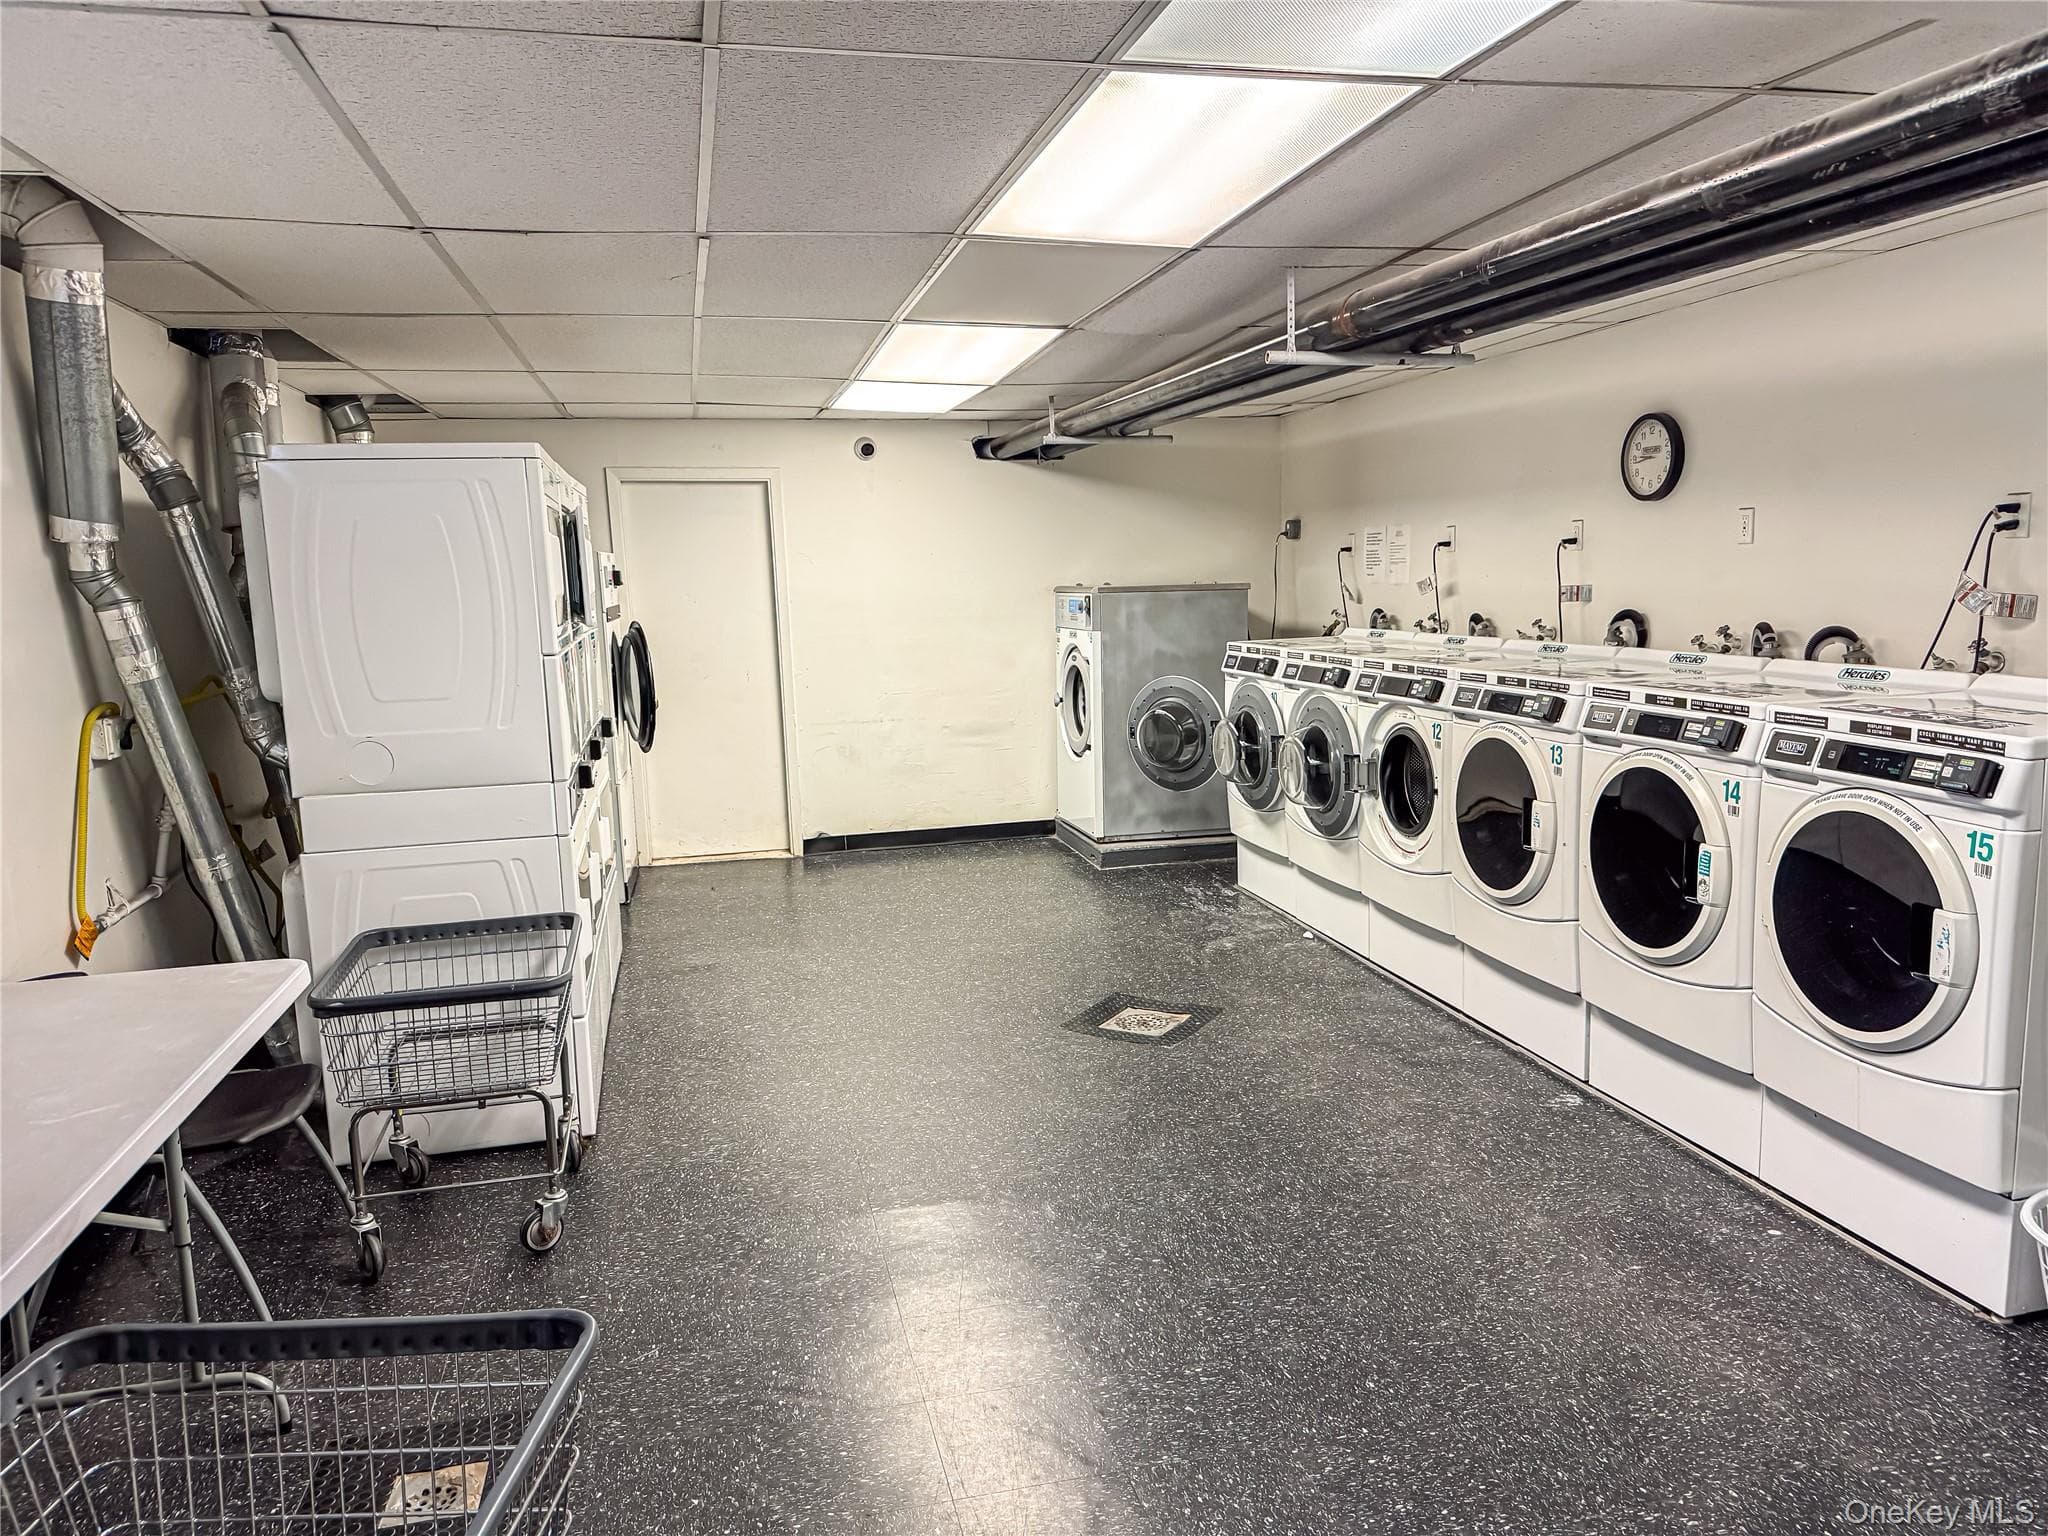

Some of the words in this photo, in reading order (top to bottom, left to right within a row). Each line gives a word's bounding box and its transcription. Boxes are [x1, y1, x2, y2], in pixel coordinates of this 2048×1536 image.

[1649, 426, 1656, 434] 12
[1641, 432, 1647, 441] 11
[1635, 441, 1642, 451] 10
[1634, 468, 1640, 478] 8
[1640, 477, 1645, 486] 7
[1647, 479, 1653, 489] 6
[1672, 653, 1705, 664] Hercules
[1842, 667, 1888, 681] Hercules
[1432, 722, 1442, 740] 12
[1919, 730, 1935, 738] CYCLE
[1937, 733, 1952, 741] TIMES
[1967, 737, 1981, 745] VARY
[1983, 739, 1994, 747] DUE
[1778, 740, 1805, 751] MAYTAG
[1550, 744, 1563, 765] 13
[1722, 779, 1741, 804] 14
[1863, 795, 1878, 803] OPEN
[1878, 798, 1894, 811] WHEN
[1893, 806, 1906, 817] NOT
[1903, 814, 1912, 823] IN
[1910, 820, 1922, 832] USE
[1967, 830, 1994, 862] 15
